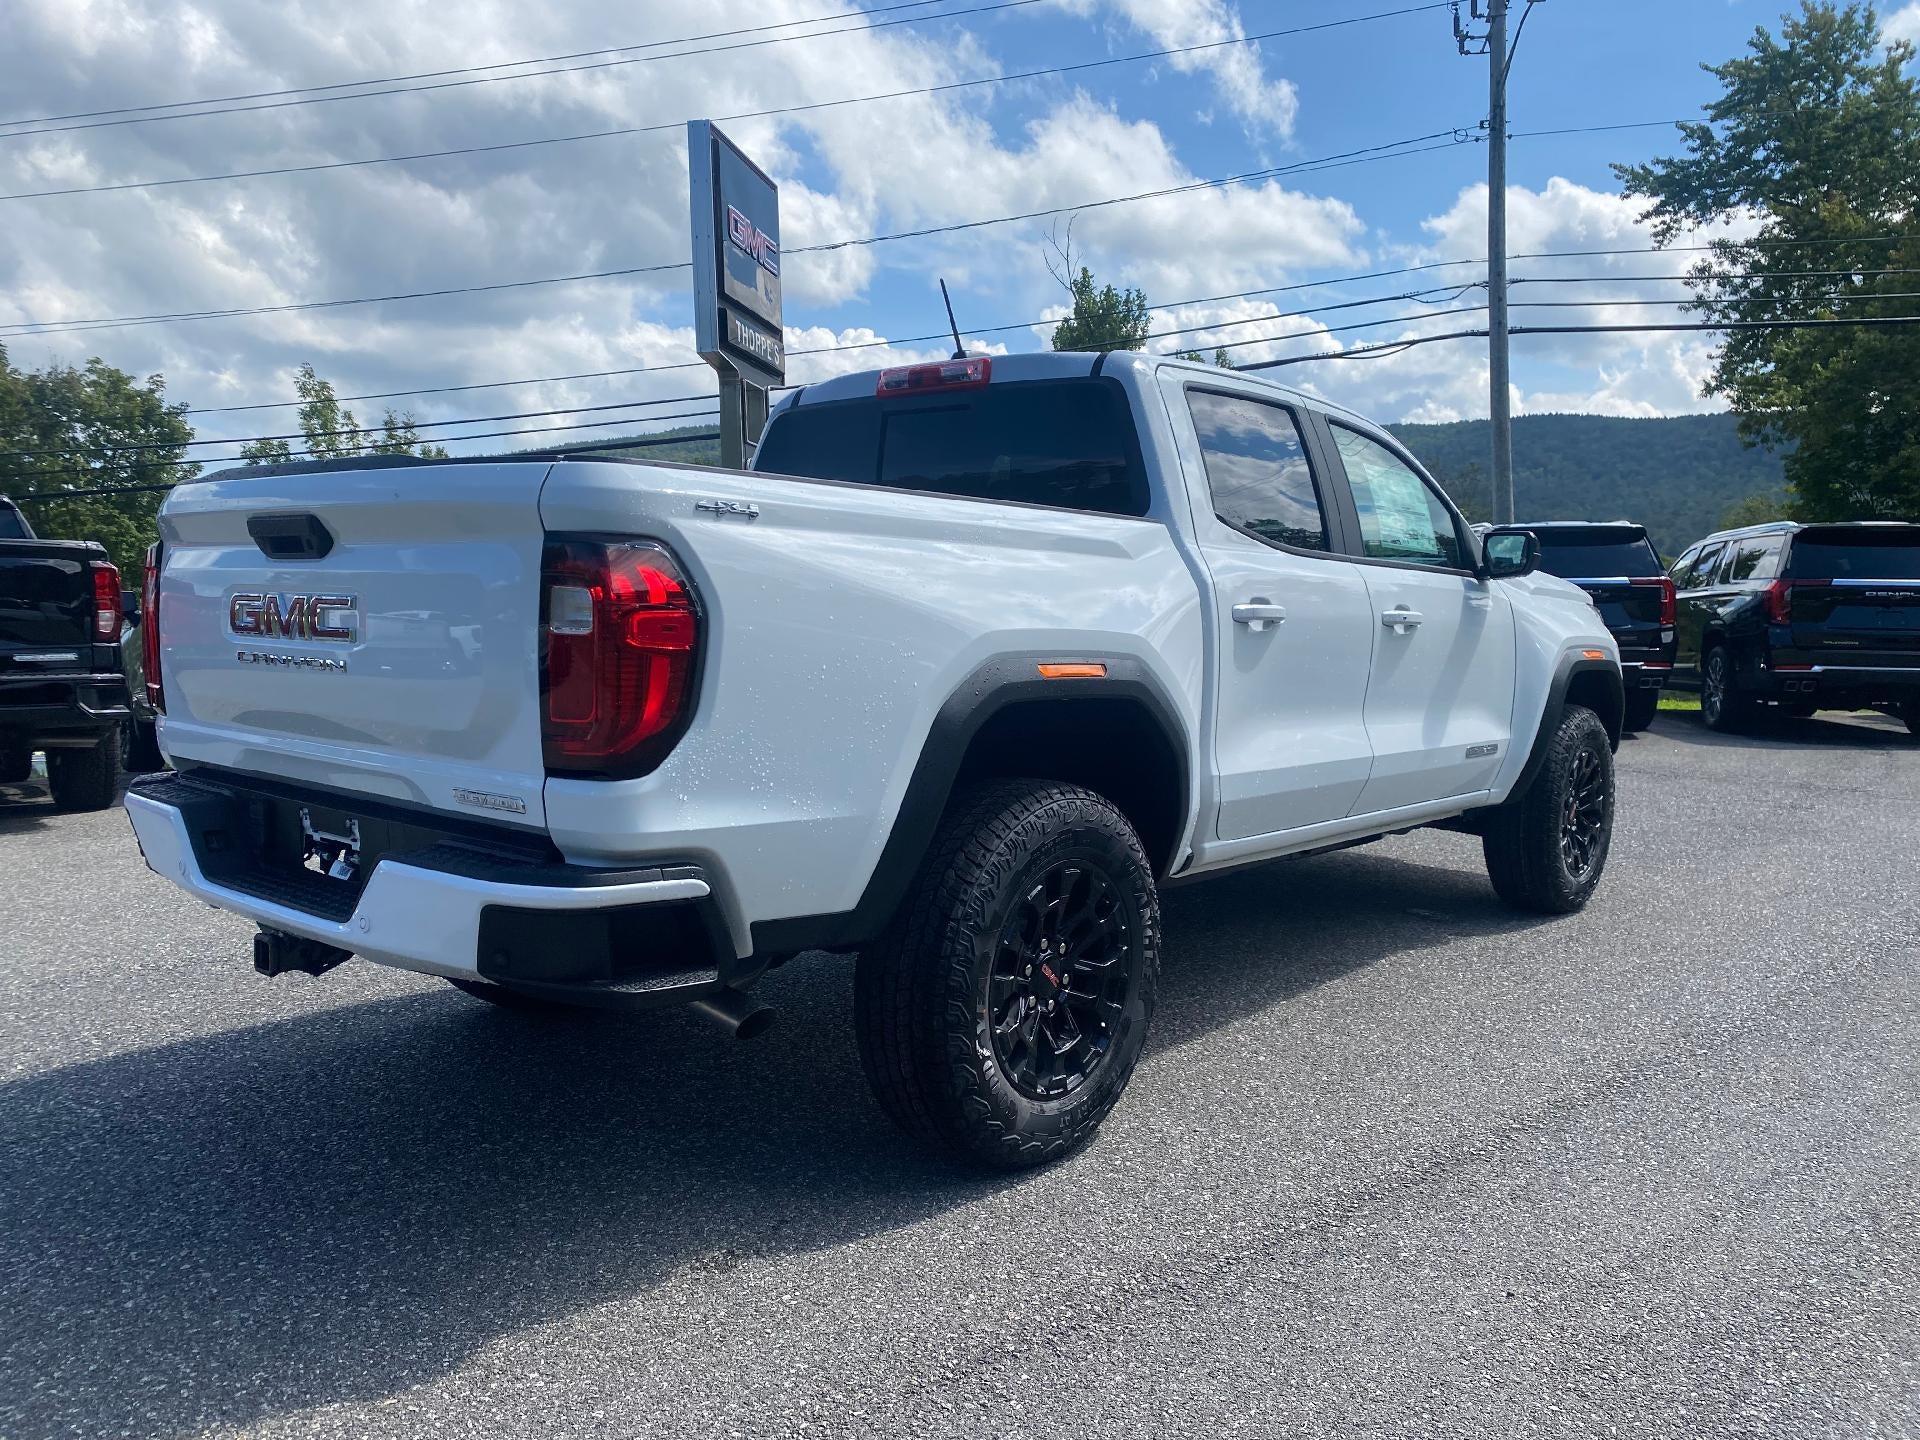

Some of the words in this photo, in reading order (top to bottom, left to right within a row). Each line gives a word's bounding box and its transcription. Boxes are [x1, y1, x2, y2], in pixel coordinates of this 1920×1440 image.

[727, 205, 779, 278] GMC
[735, 319, 780, 365] THORPE'S
[229, 592, 357, 641] GMC
[237, 650, 348, 673] CANYON
